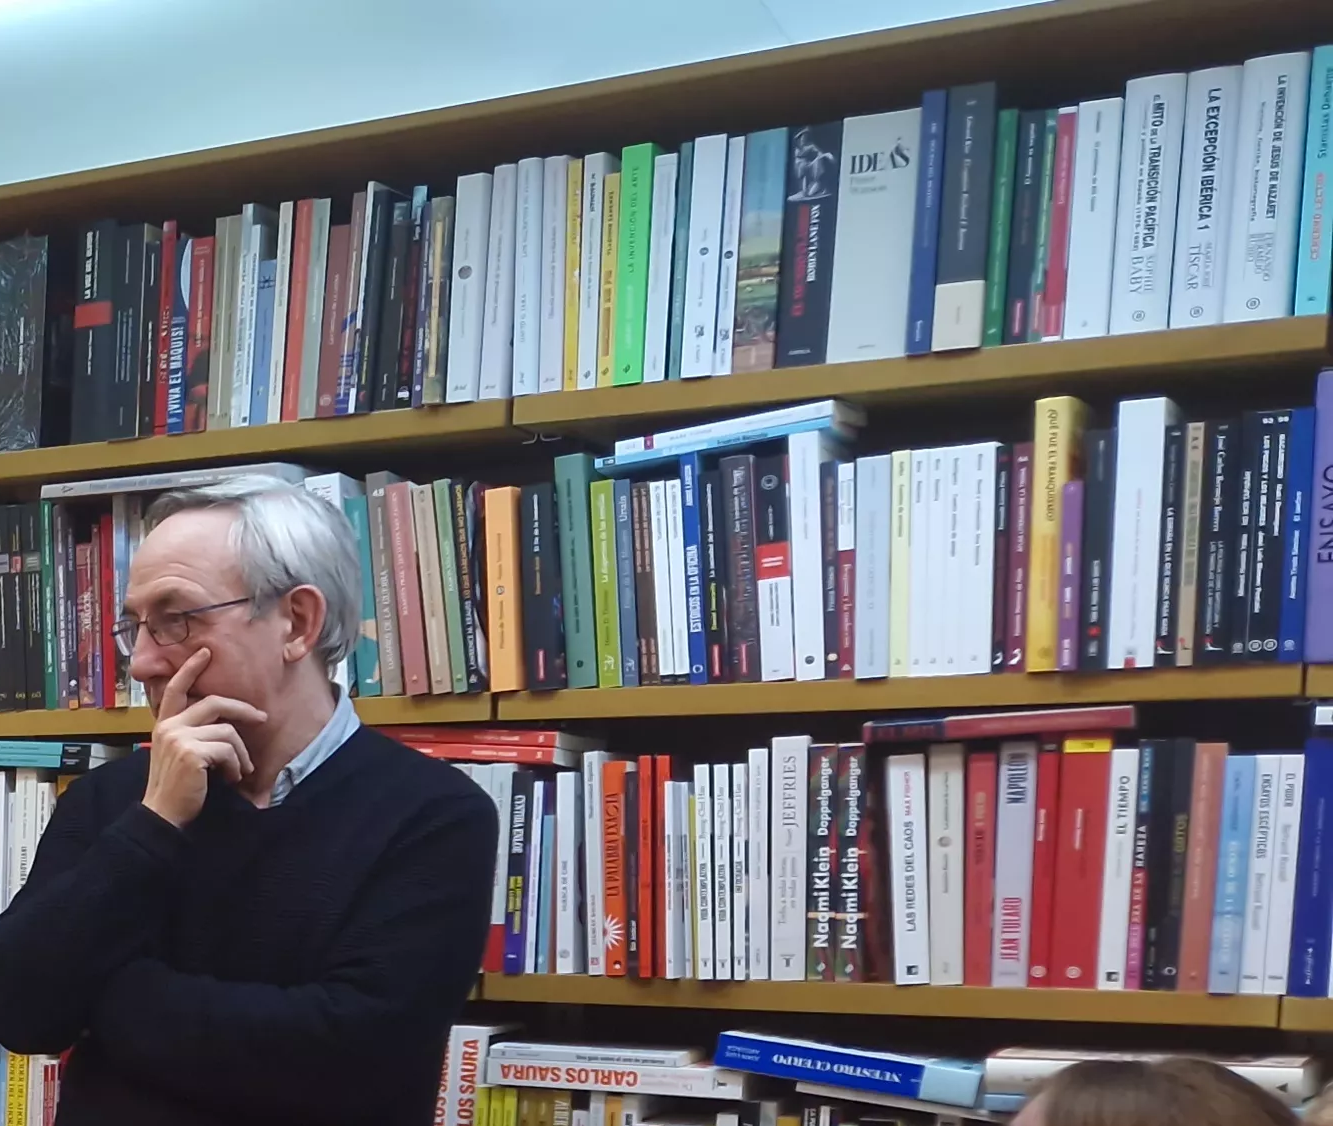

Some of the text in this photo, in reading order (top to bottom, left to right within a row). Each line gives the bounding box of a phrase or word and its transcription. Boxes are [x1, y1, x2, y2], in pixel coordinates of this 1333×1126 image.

[1206, 88, 1222, 103] LA
[1200, 105, 1221, 173] EXCEPCIÓN
[1265, 74, 1288, 220] LA INVENCIÓN DE DE NAZARET
[1316, 114, 1330, 159] Stanislas
[1141, 102, 1165, 249] MITO TRANSICIÓN PACÍFICA
[1197, 174, 1217, 221] IBÉRICA
[83, 258, 93, 300] LA DEL
[1129, 256, 1144, 294] BABY
[1186, 244, 1203, 291] TÍSCAR
[166, 326, 185, 414] ¡VIVA EL MAQUIS!
[1048, 450, 1058, 460] EL
[381, 606, 392, 618] LA
[686, 544, 703, 633] ESTOICOS LA OFICINA
[781, 754, 799, 828] JEFFRIES
[1006, 752, 1028, 805] NAPOLEÓN
[1283, 772, 1297, 808] EL PODER
[511, 794, 526, 854] CYNTHIA ENLOE
[1116, 775, 1131, 835] EL TIEMPO
[1255, 773, 1273, 859] ENSAYOS ESCÉPTICOS
[604, 792, 620, 897] LA PALABRA EXACTA
[809, 755, 833, 948] Naomi Klein Doppelganger
[838, 755, 862, 949] Naomi Klein Doppelganger
[699, 862, 708, 907] CONTEMPLATIVA
[717, 863, 726, 909] CONTEMPLATIVA
[903, 820, 917, 932] LAS REDES DEL CAOS
[999, 938, 1020, 962] JEAN
[18, 1055, 26, 1082] PODER
[459, 1038, 479, 1095] SAURA
[500, 1064, 639, 1088] CARLOS SAURA
[771, 1053, 902, 1084] NUESTRO CUERPO
